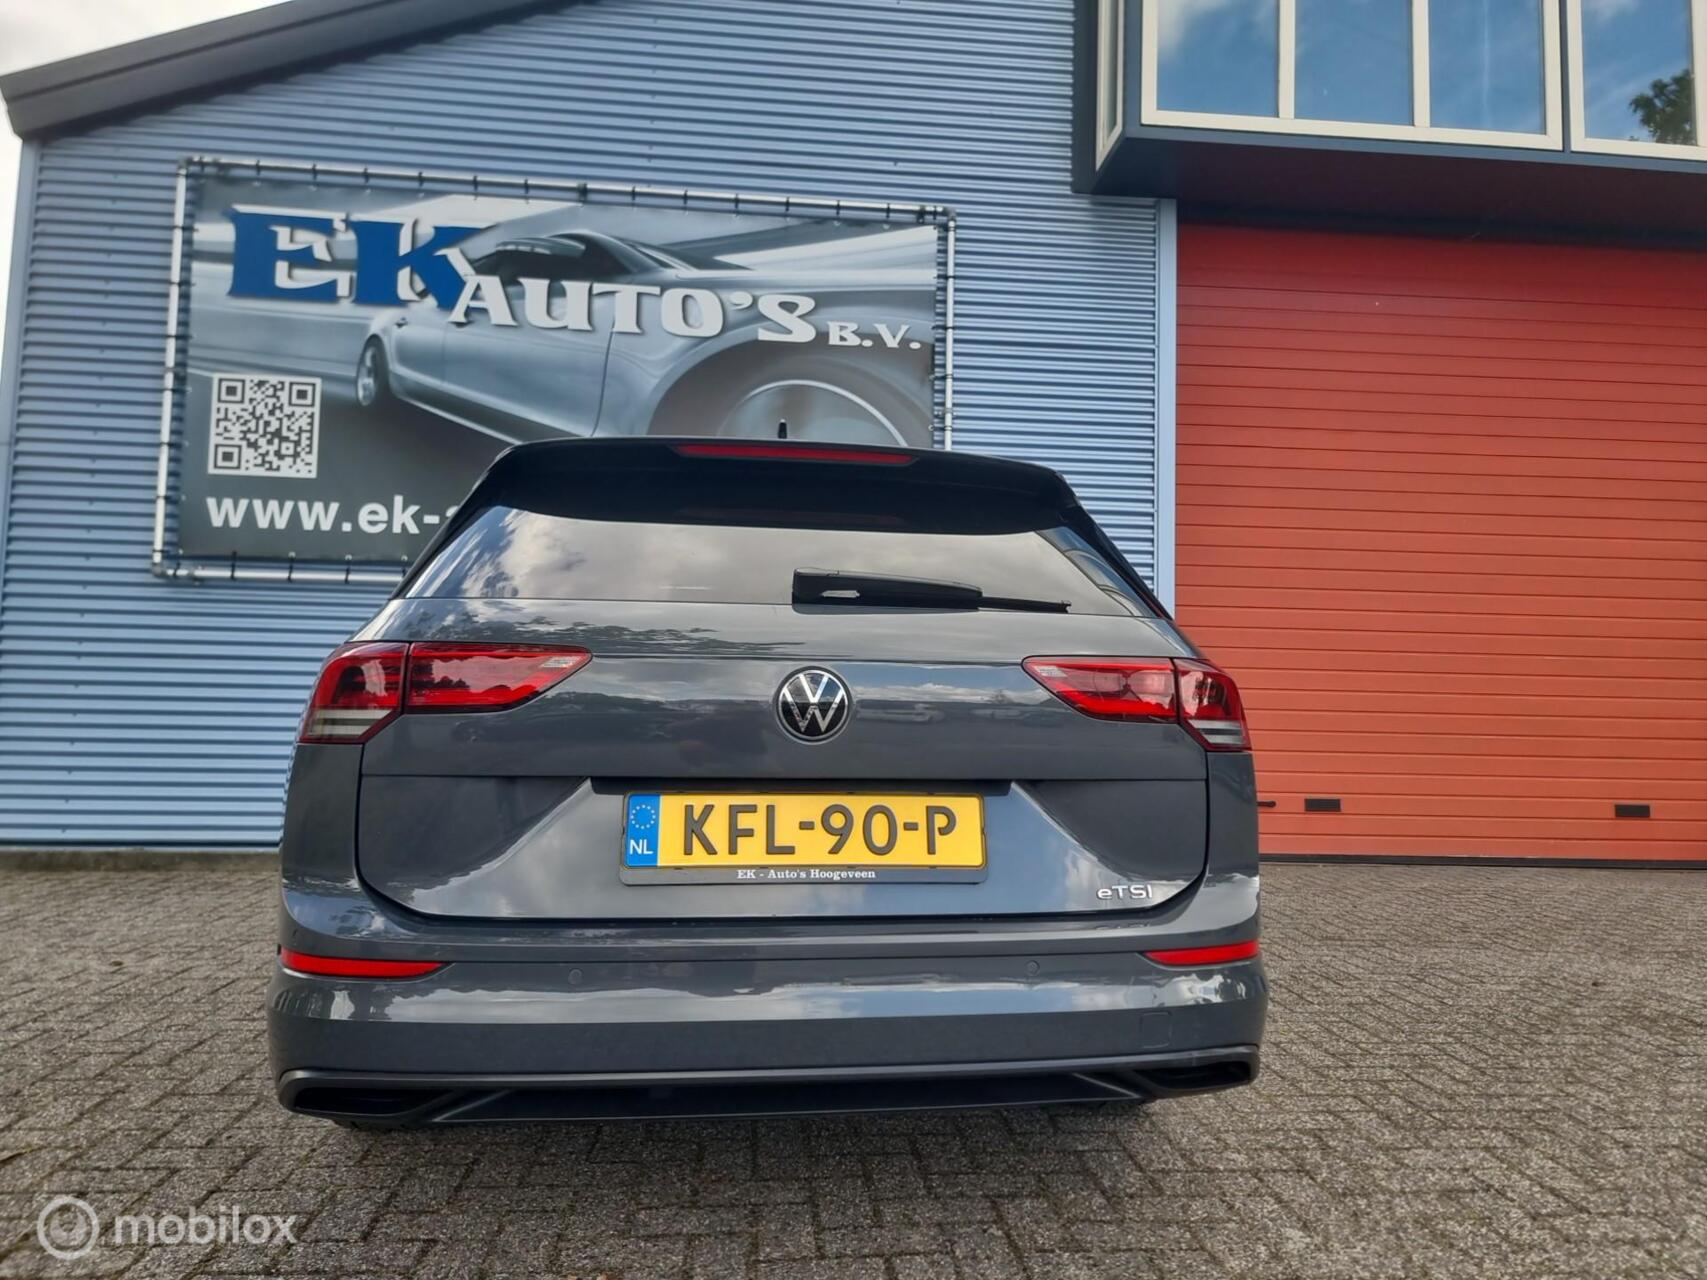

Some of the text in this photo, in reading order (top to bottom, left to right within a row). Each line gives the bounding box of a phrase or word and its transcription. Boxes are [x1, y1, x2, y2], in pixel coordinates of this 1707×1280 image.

[228, 205, 498, 311] EK
[828, 321, 921, 350] B.V.
[206, 495, 456, 534] www.ek-
[683, 804, 957, 856] KFL-90-P
[629, 839, 653, 855] NL
[736, 869, 756, 879] EK
[767, 869, 807, 879] Auto's
[809, 869, 876, 880] Hoogeveen
[1097, 884, 1153, 899] eTSI
